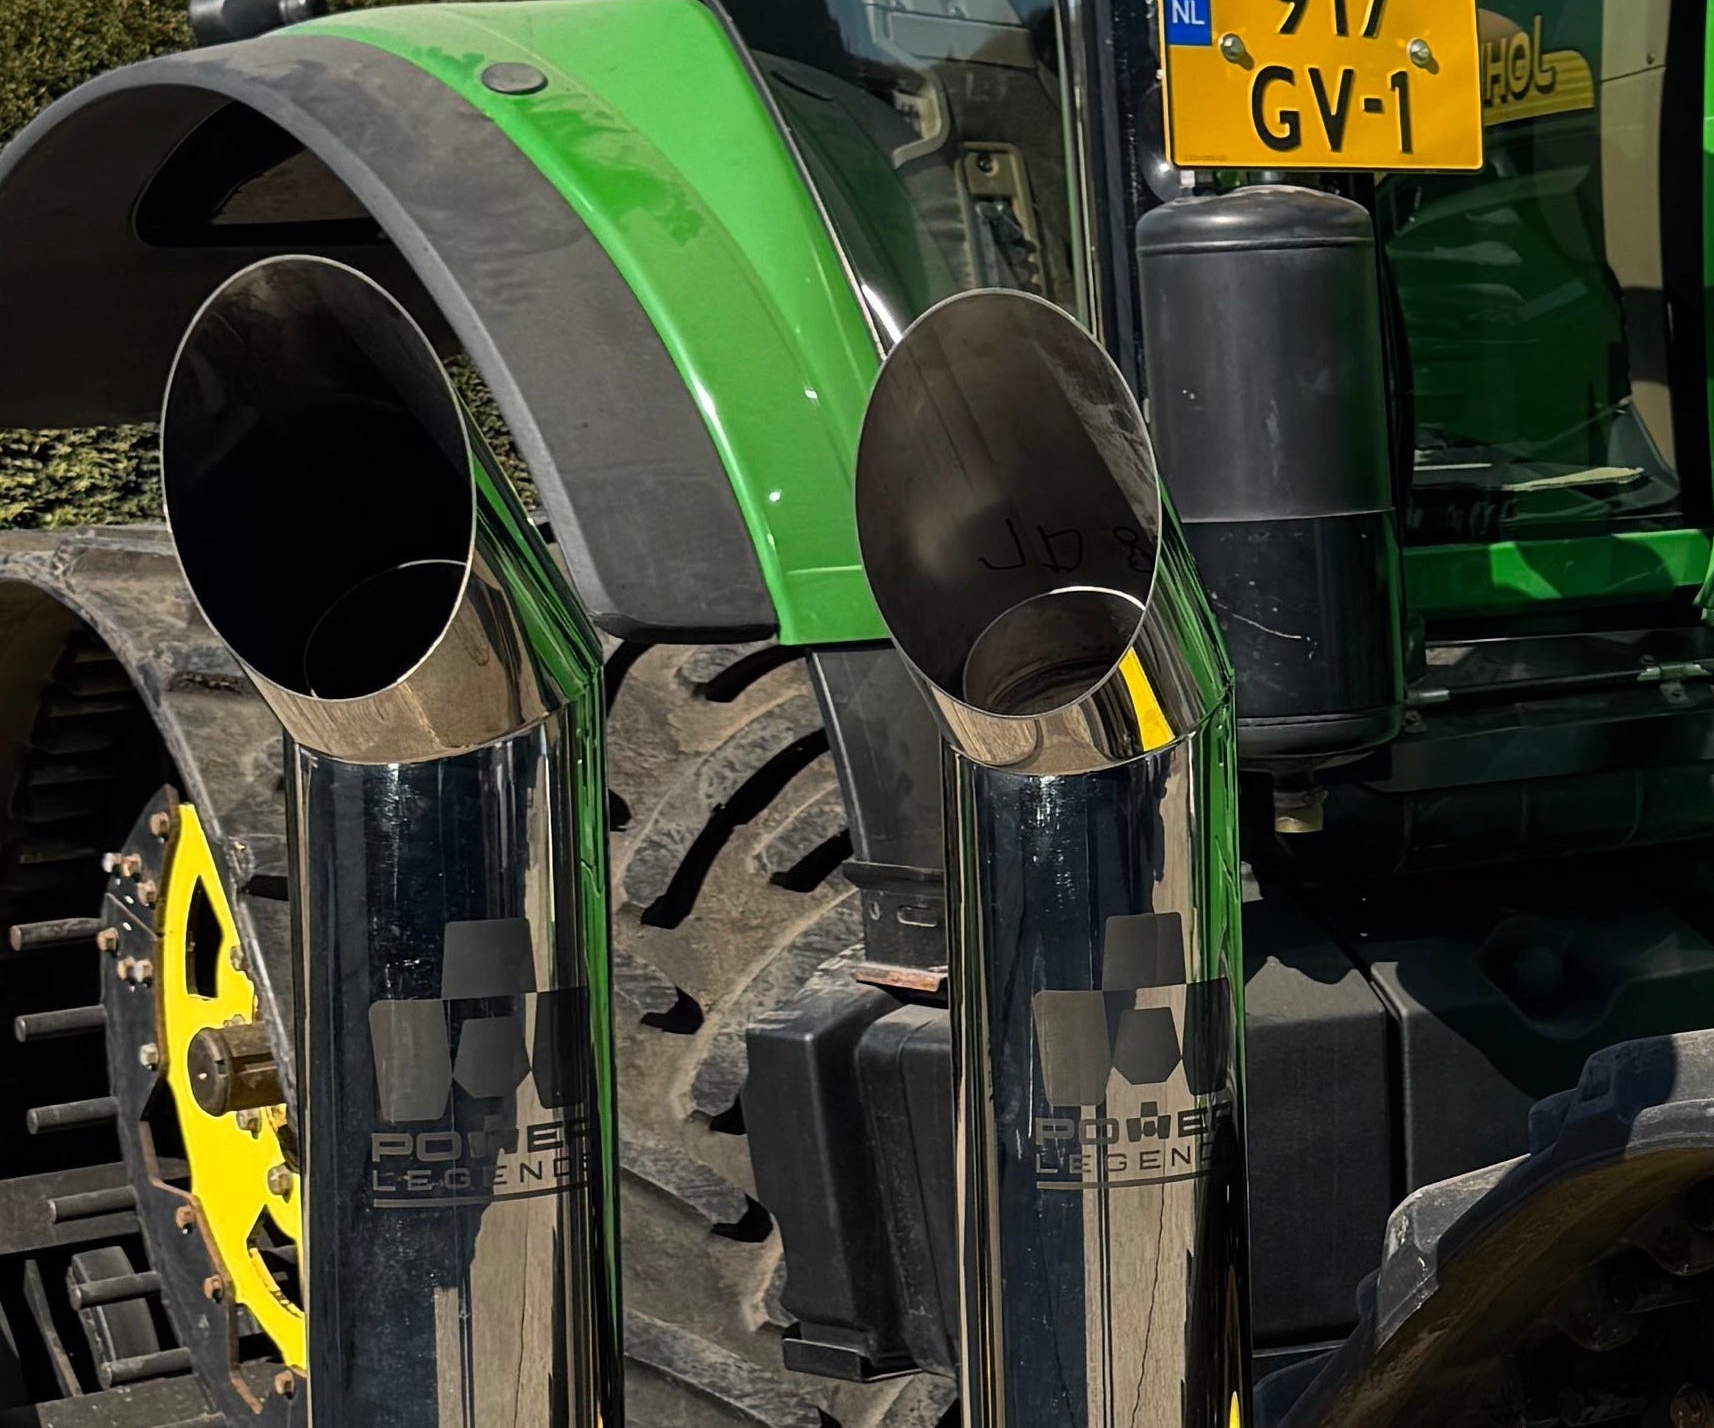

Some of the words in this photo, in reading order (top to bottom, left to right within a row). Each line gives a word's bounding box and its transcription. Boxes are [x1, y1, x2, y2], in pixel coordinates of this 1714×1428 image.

[1250, 65, 1414, 155] GV-1
[372, 1154, 590, 1193] LEGEND
[1036, 1141, 1214, 1174] LEGEND
